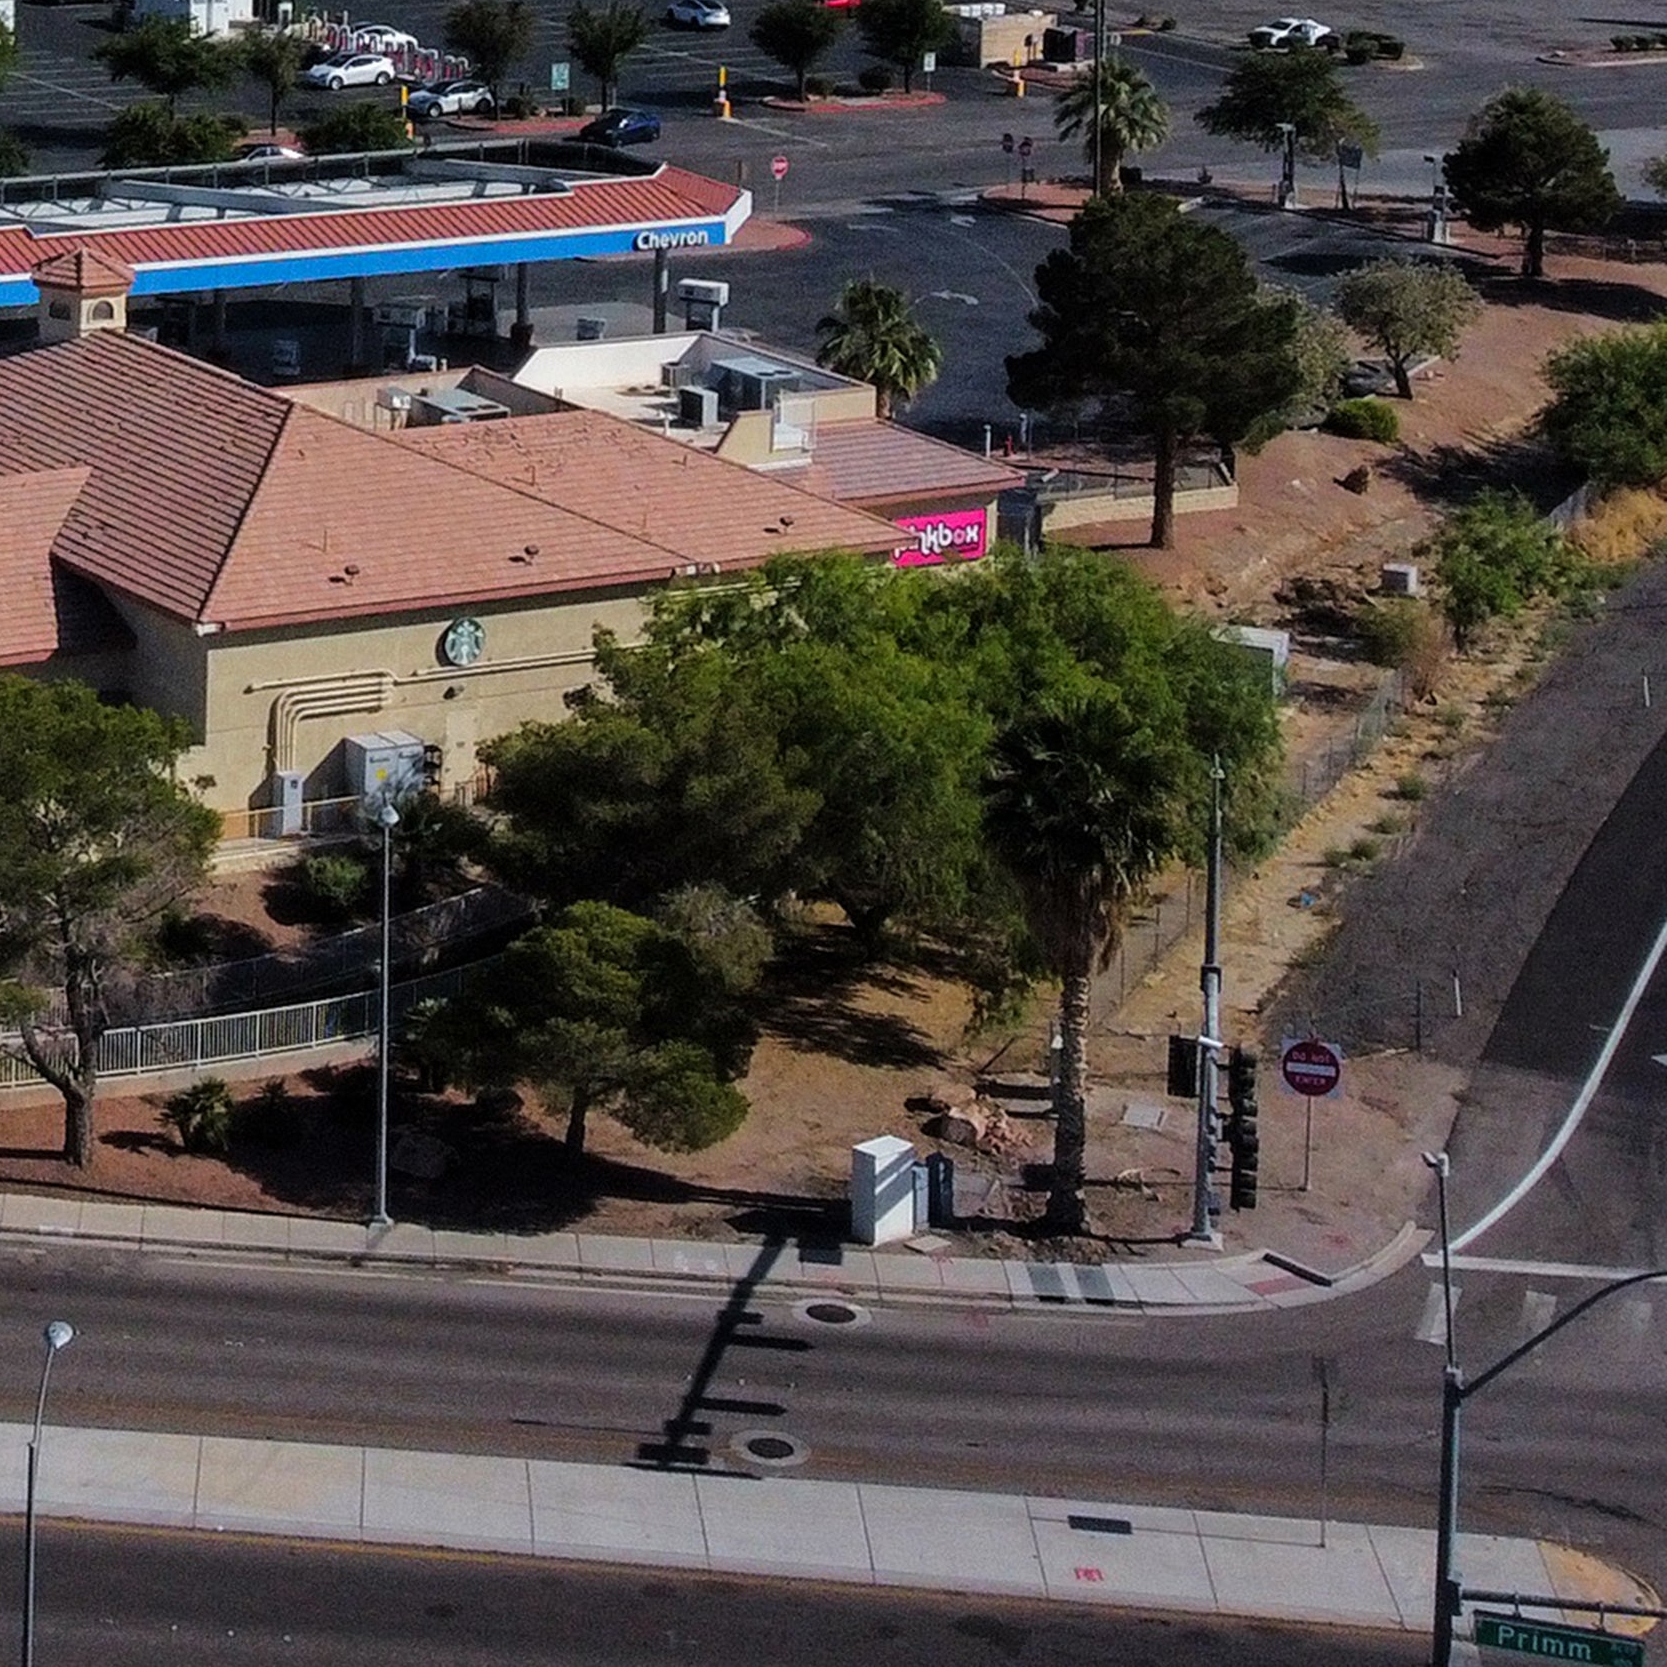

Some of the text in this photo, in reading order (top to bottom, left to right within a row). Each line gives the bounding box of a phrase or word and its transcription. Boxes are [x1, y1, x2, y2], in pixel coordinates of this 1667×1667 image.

[636, 231, 708, 249] Chevron
[1291, 1051, 1306, 1061] DO
[1498, 1625, 1592, 1660] Primm
